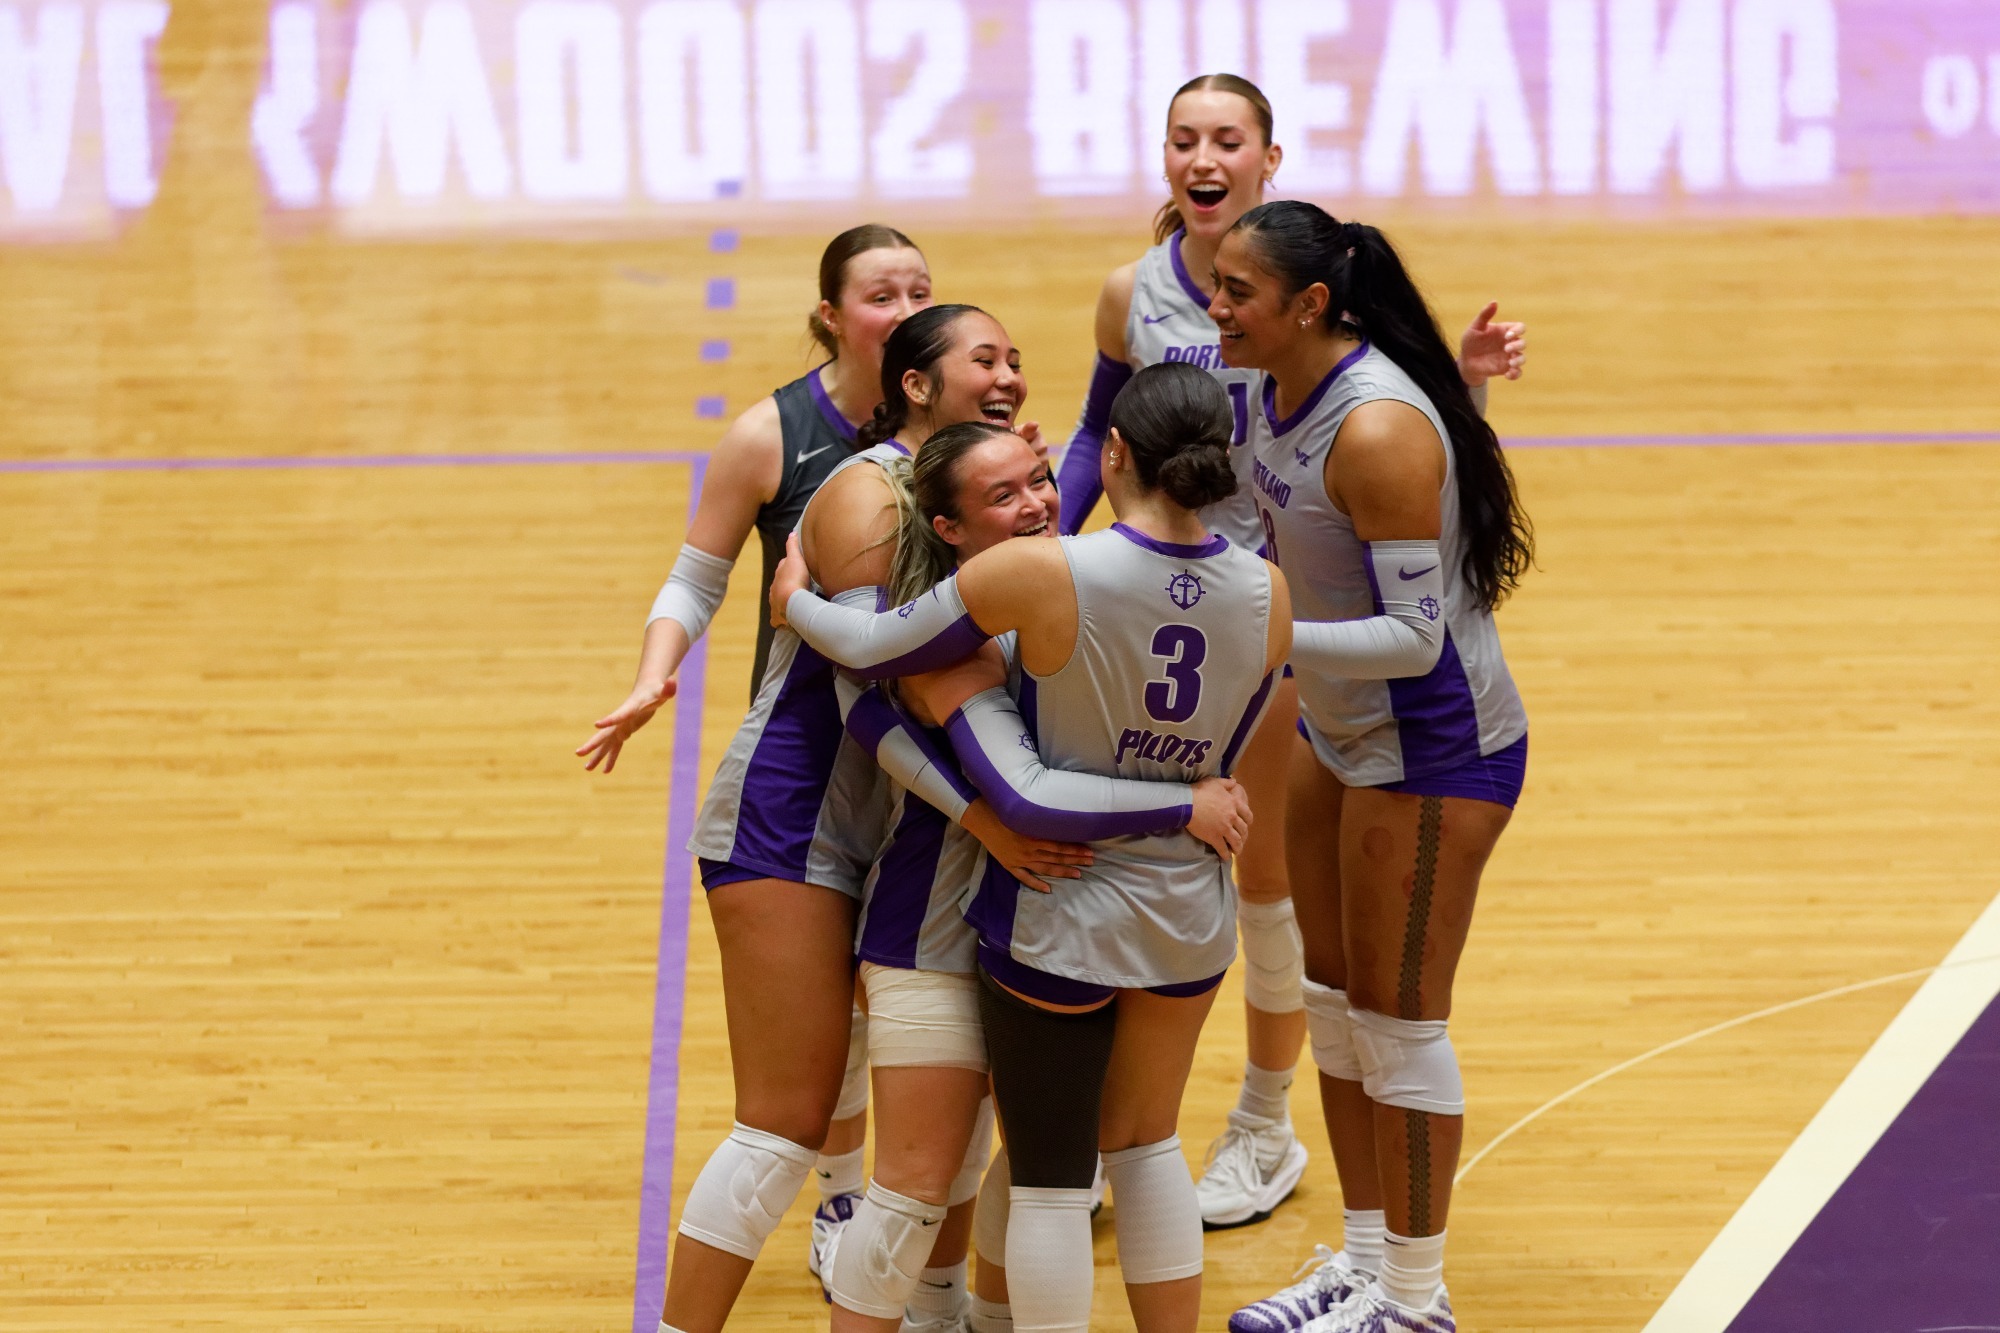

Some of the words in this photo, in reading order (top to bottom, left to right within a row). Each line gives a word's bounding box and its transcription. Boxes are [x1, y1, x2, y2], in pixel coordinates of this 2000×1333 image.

[1163, 344, 1230, 371] PORT
[1253, 455, 1291, 509] RTLAND
[1144, 622, 1208, 724] 3
[1114, 727, 1213, 769] PILOTS
